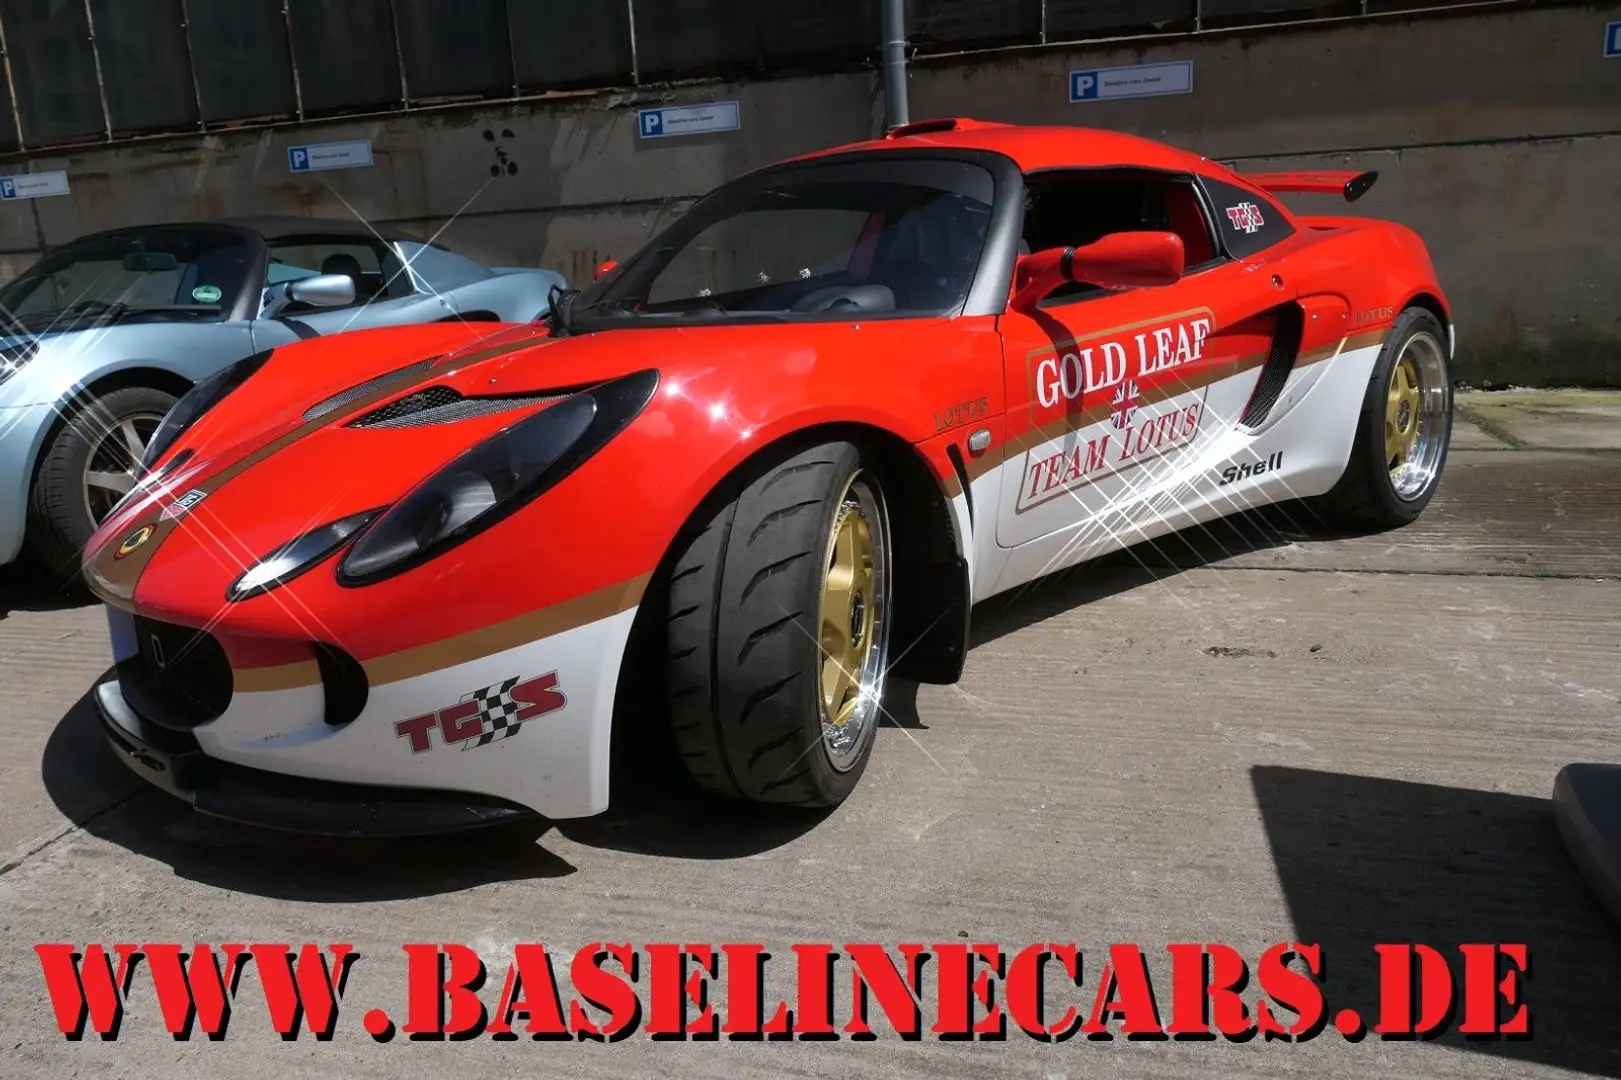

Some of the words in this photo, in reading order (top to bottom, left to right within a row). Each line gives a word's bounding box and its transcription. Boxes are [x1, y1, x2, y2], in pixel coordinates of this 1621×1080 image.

[1036, 341, 1127, 408] GOLD
[1134, 318, 1210, 377] LEAF
[934, 396, 988, 432] LOTUS
[1027, 434, 1111, 500] TEAM
[1118, 402, 1199, 462] LOTUS
[1219, 450, 1284, 487] Shell
[393, 669, 568, 755] TGS
